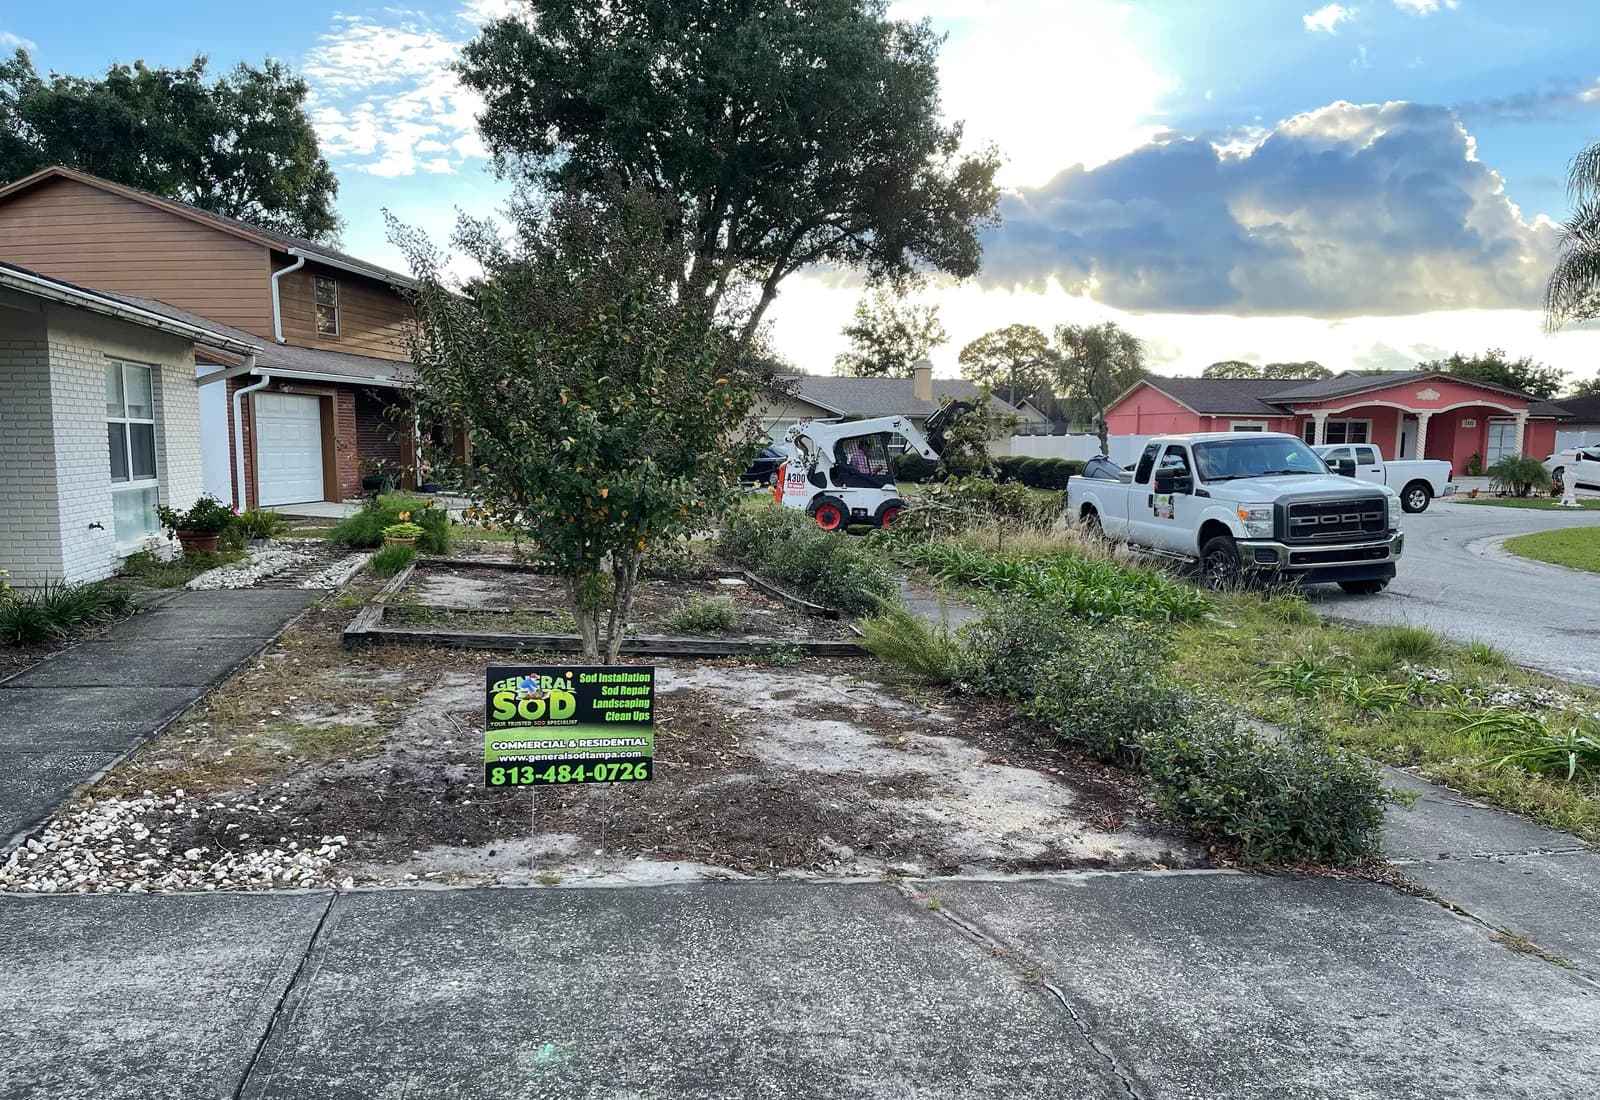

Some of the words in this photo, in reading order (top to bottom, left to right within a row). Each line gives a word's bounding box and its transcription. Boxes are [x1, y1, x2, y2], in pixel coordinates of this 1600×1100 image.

[579, 673, 597, 683] Sod
[599, 673, 651, 683] Installation
[601, 685, 619, 695] Sod
[620, 685, 651, 696] Repair
[493, 689, 576, 720] SOD
[593, 698, 650, 709] Landscaping
[605, 711, 631, 721] Clean
[633, 711, 650, 722] Ups
[492, 741, 566, 750] COMMERCIAL
[568, 740, 577, 748] &
[579, 738, 648, 747] RESIDENTIAL
[499, 750, 641, 762] www.generalsodtampa.com
[491, 762, 647, 785] 813-484-0726
